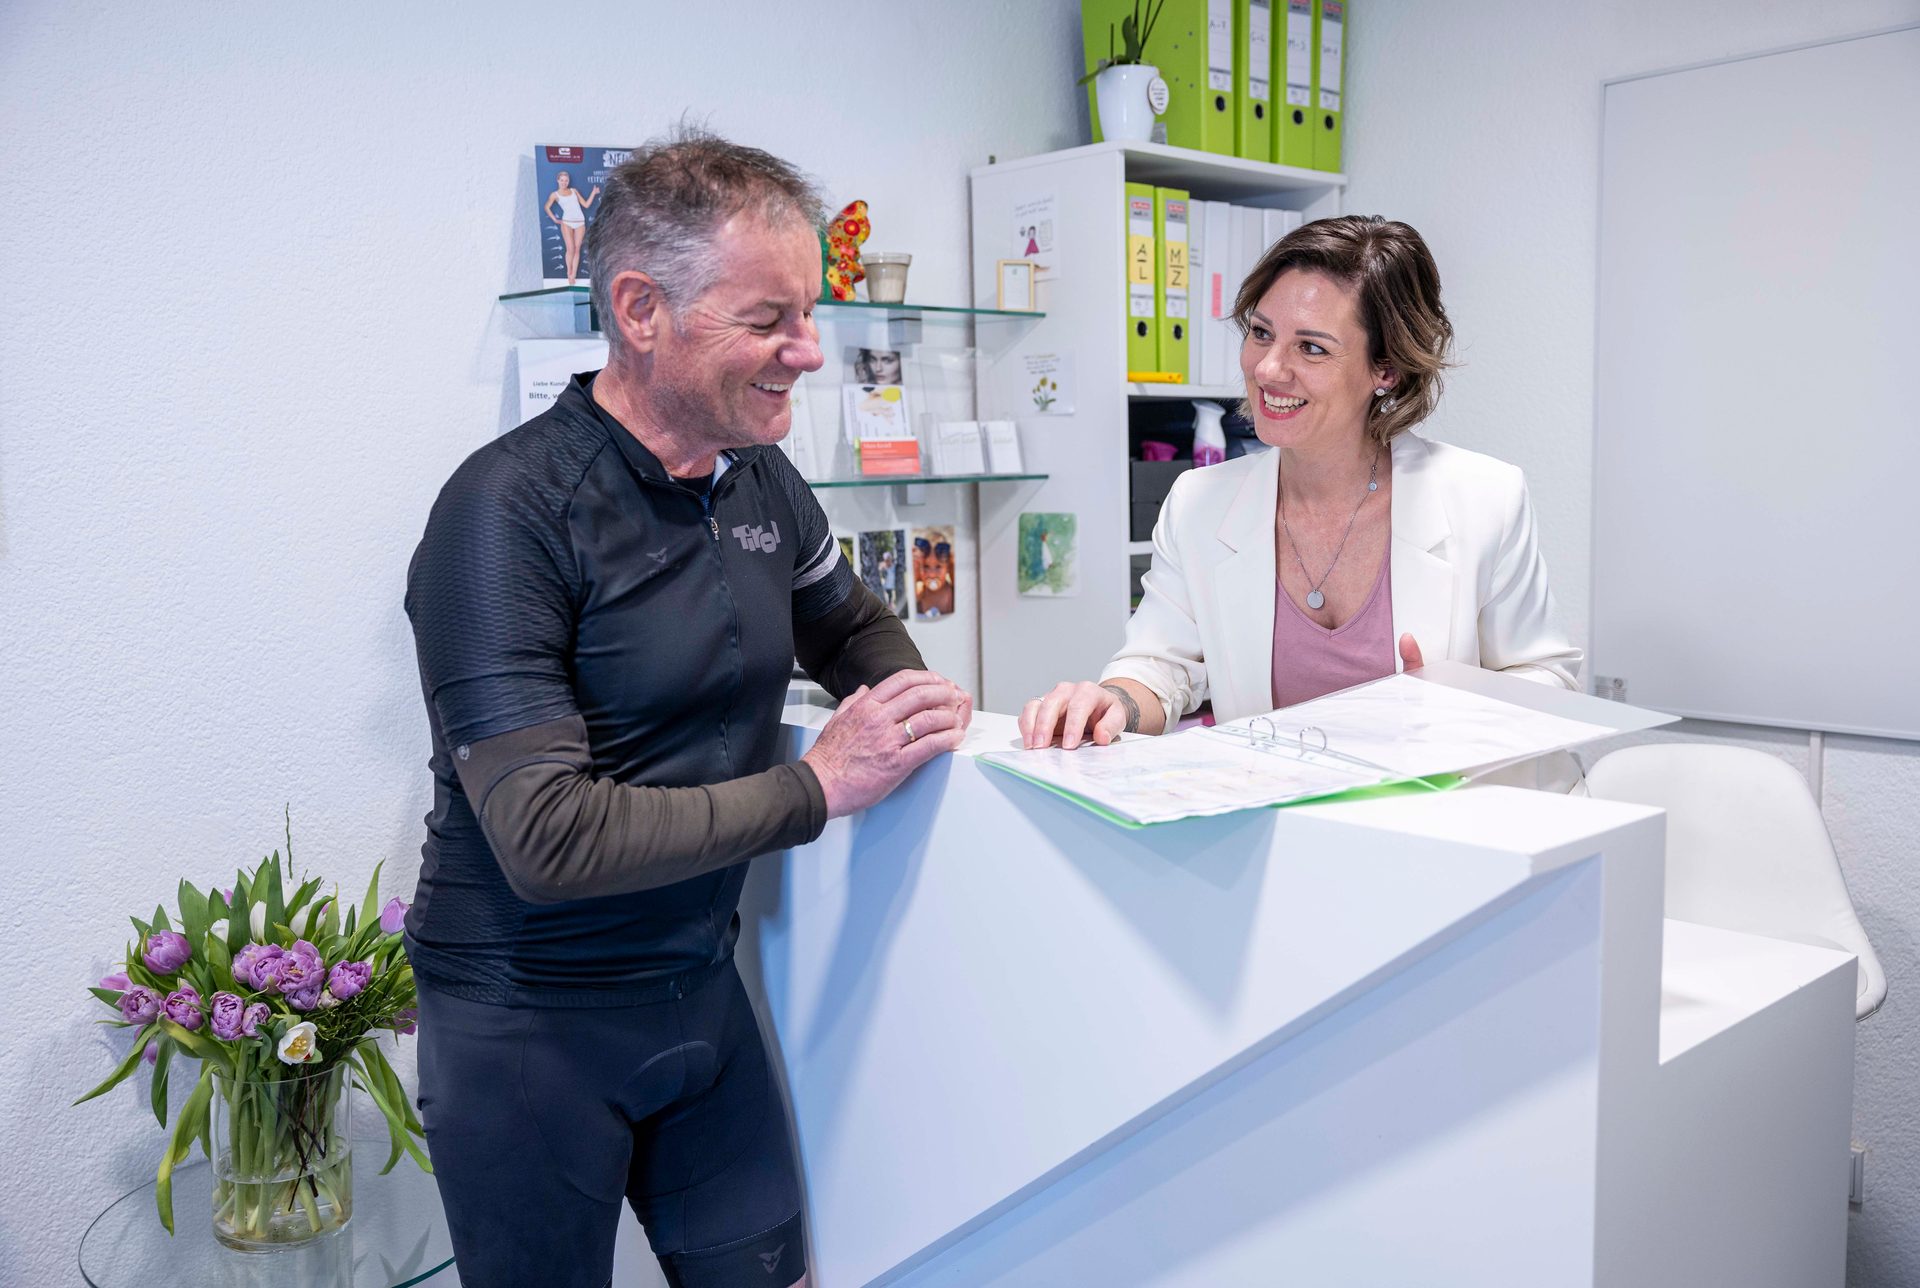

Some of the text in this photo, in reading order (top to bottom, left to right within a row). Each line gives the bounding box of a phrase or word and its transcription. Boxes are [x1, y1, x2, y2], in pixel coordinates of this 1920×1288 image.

[1136, 243, 1147, 256] A
[1169, 248, 1181, 264] M
[1138, 265, 1147, 280] L
[1171, 270, 1181, 286] Z
[529, 392, 551, 400] Bitte,
[732, 520, 781, 553] Tirol
